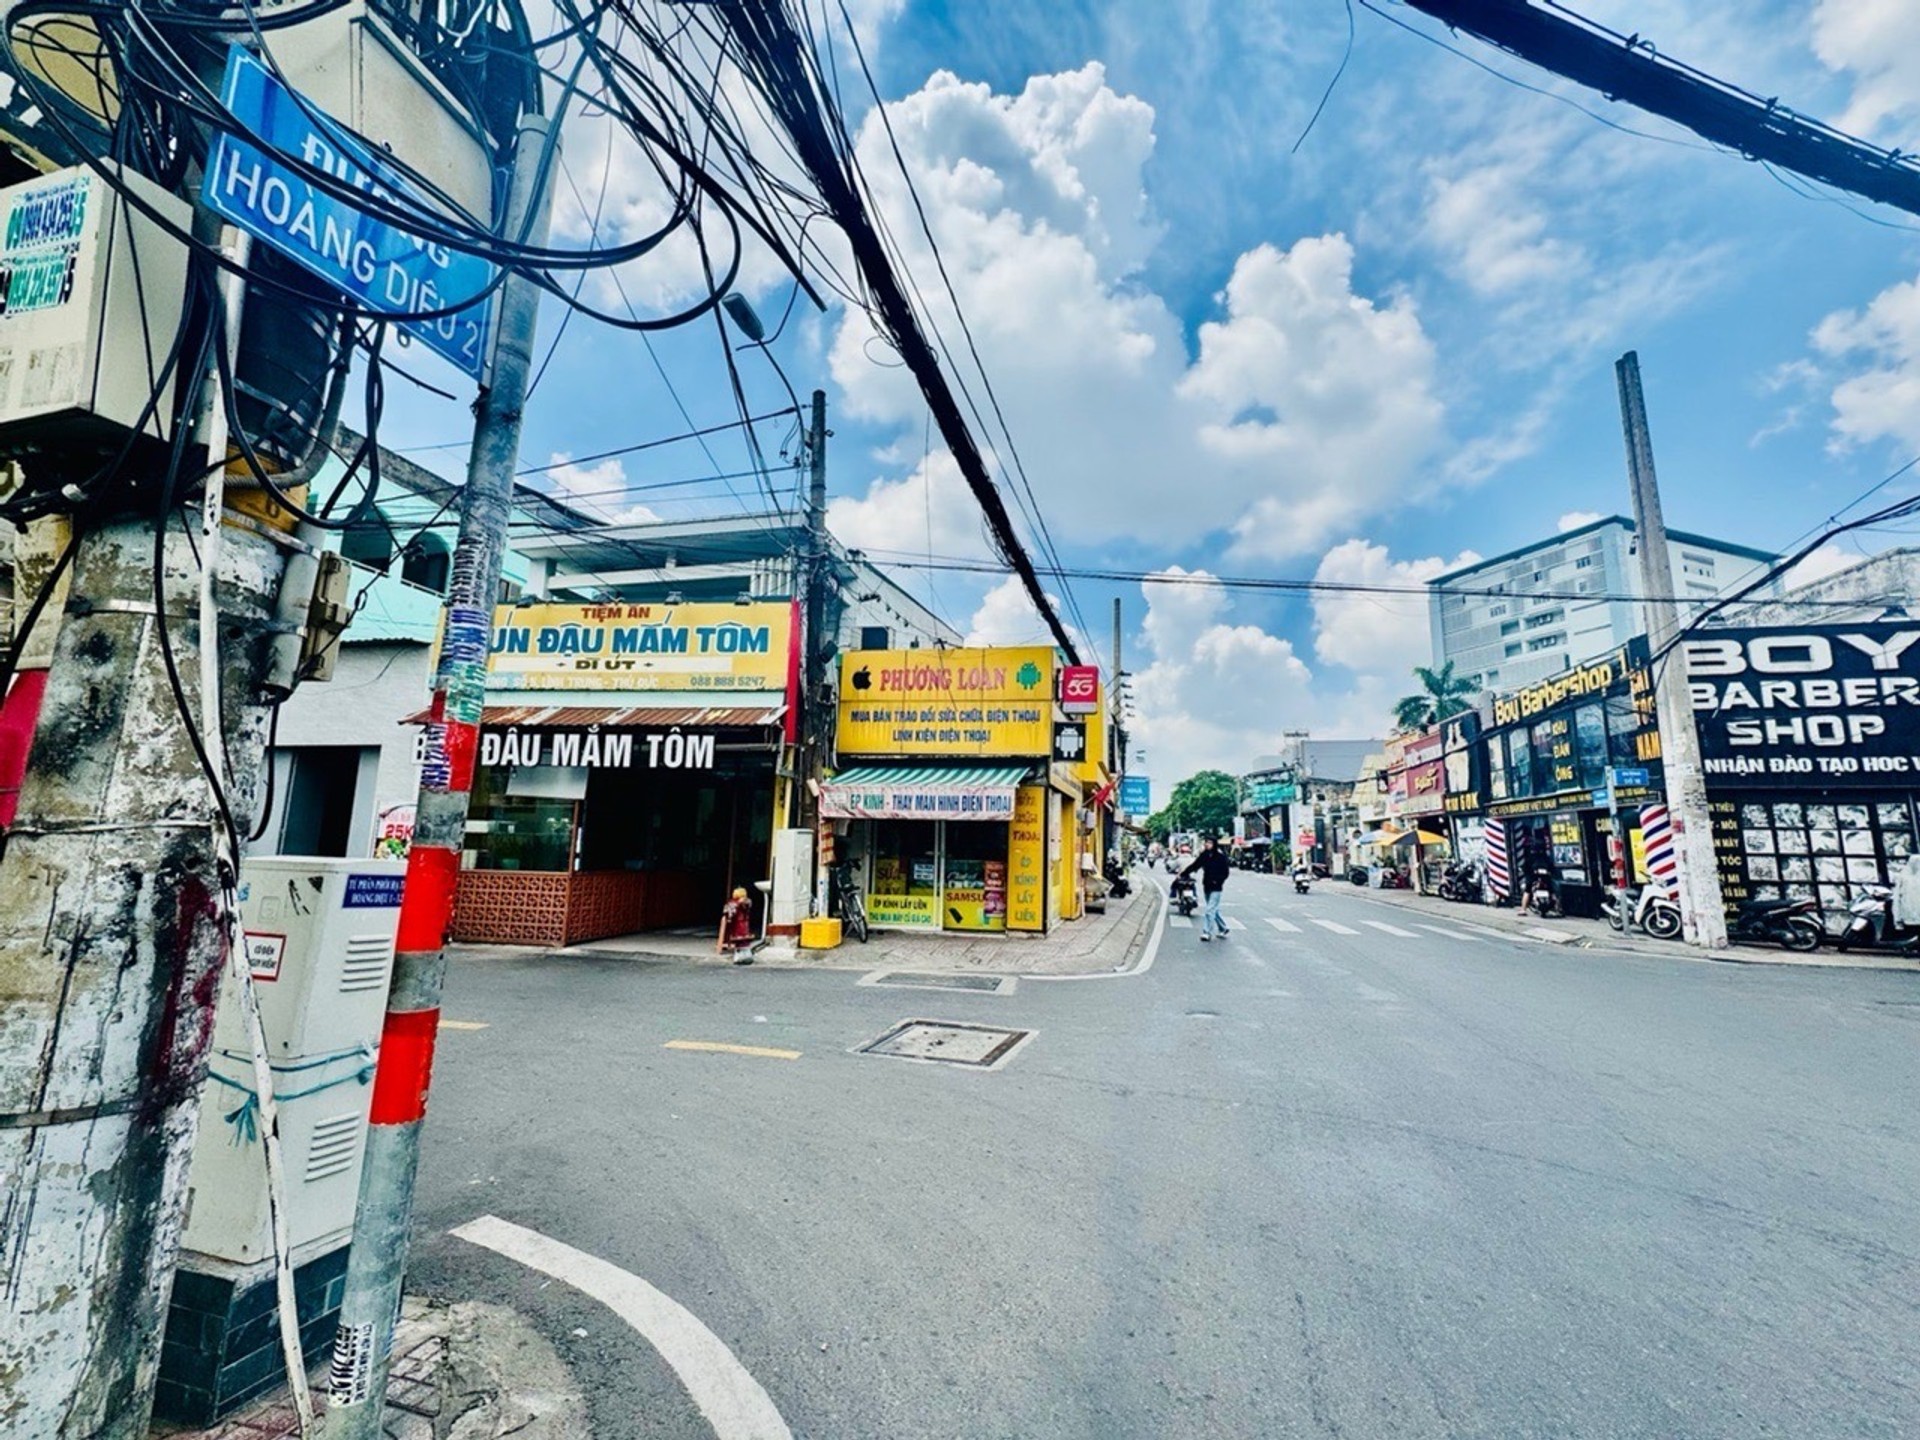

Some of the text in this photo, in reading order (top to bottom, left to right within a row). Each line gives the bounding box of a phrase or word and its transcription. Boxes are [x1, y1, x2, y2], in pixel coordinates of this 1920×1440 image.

[226, 149, 480, 359] HOÀNG DIỆU 2
[536, 622, 604, 657] ĐẬU
[612, 610, 689, 653] MẮM
[696, 621, 769, 653] TÔM
[1682, 630, 1920, 676] BOY
[1067, 680, 1094, 696] 5G
[1494, 698, 1520, 728] Boy
[1520, 665, 1612, 717] Barbershop
[1688, 676, 1920, 710] BARBER
[646, 726, 715, 769] TÔM
[1726, 714, 1886, 746] SHOP
[1704, 755, 1765, 777] NHẬN
[1769, 754, 1812, 773] ĐÀO
[1816, 756, 1858, 776] TẠO
